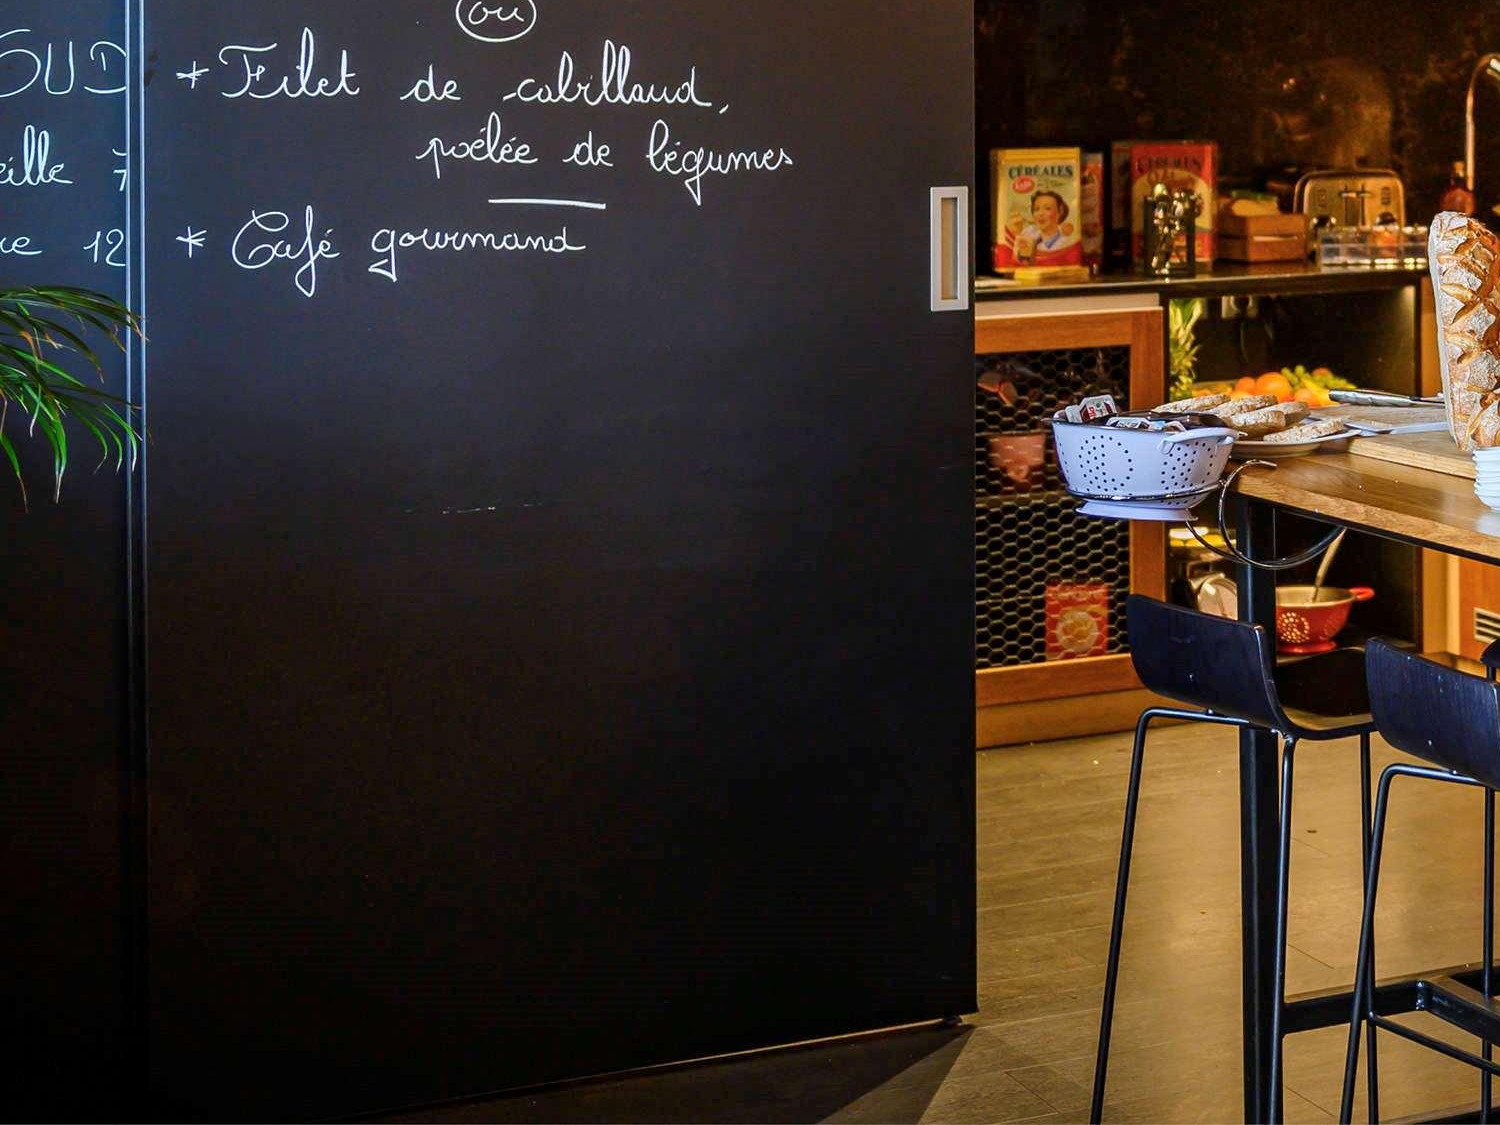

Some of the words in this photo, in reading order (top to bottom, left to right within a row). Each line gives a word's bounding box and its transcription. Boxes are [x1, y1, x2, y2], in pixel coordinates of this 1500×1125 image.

[468, 1, 524, 25] ou
[219, 27, 360, 98] Filet
[400, 64, 461, 102] de
[562, 129, 613, 167] de
[646, 119, 794, 206] légumes
[232, 205, 340, 297] Café
[368, 227, 587, 282] gourmand
